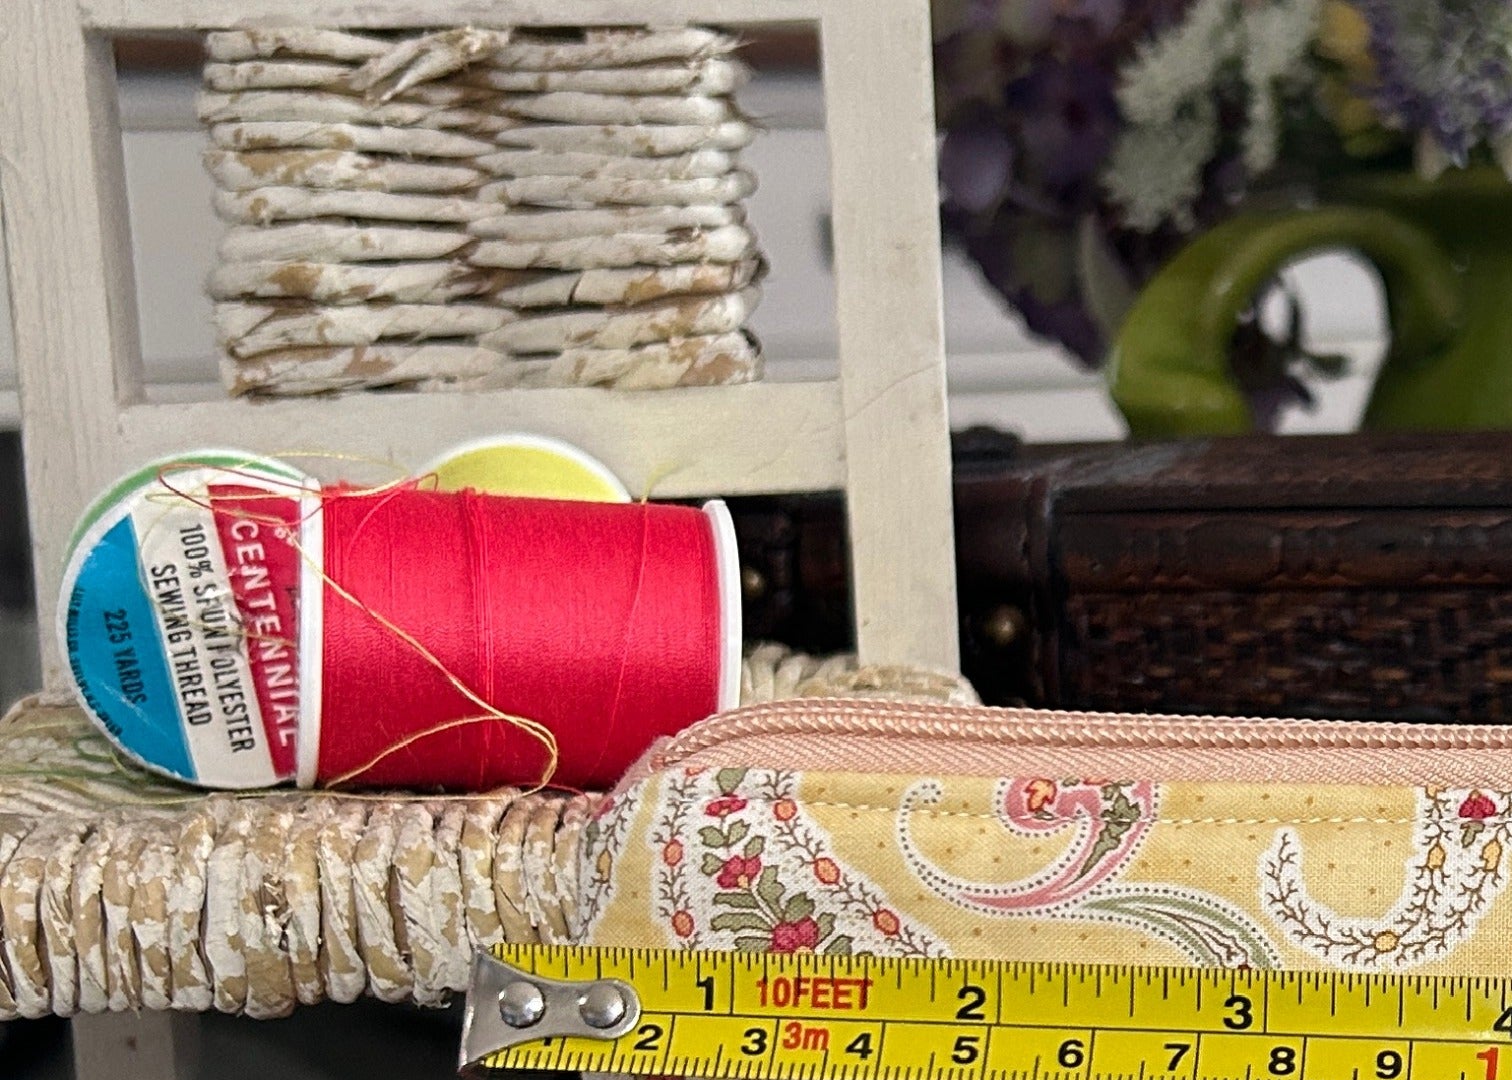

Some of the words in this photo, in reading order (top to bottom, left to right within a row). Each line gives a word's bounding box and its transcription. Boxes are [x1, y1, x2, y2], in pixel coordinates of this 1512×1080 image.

[180, 524, 214, 579] 100%
[103, 608, 132, 643] 225
[151, 563, 192, 644] SEWING
[173, 646, 213, 726] THREAD
[231, 520, 297, 748] CENTENNIAL
[114, 648, 148, 704] YARDS
[697, 977, 716, 1011] 1
[756, 978, 872, 1010] 10FEET
[956, 986, 986, 1021] 2
[1223, 996, 1254, 1030] 3
[635, 1024, 664, 1050] 2
[741, 1028, 768, 1055] 3
[783, 1023, 829, 1051] 3m
[846, 1032, 873, 1058] 4
[952, 1037, 979, 1064] 5
[1057, 1040, 1085, 1068] 6
[1163, 1044, 1190, 1071] 7
[1268, 1047, 1296, 1074] 8
[1375, 1050, 1402, 1079] 9
